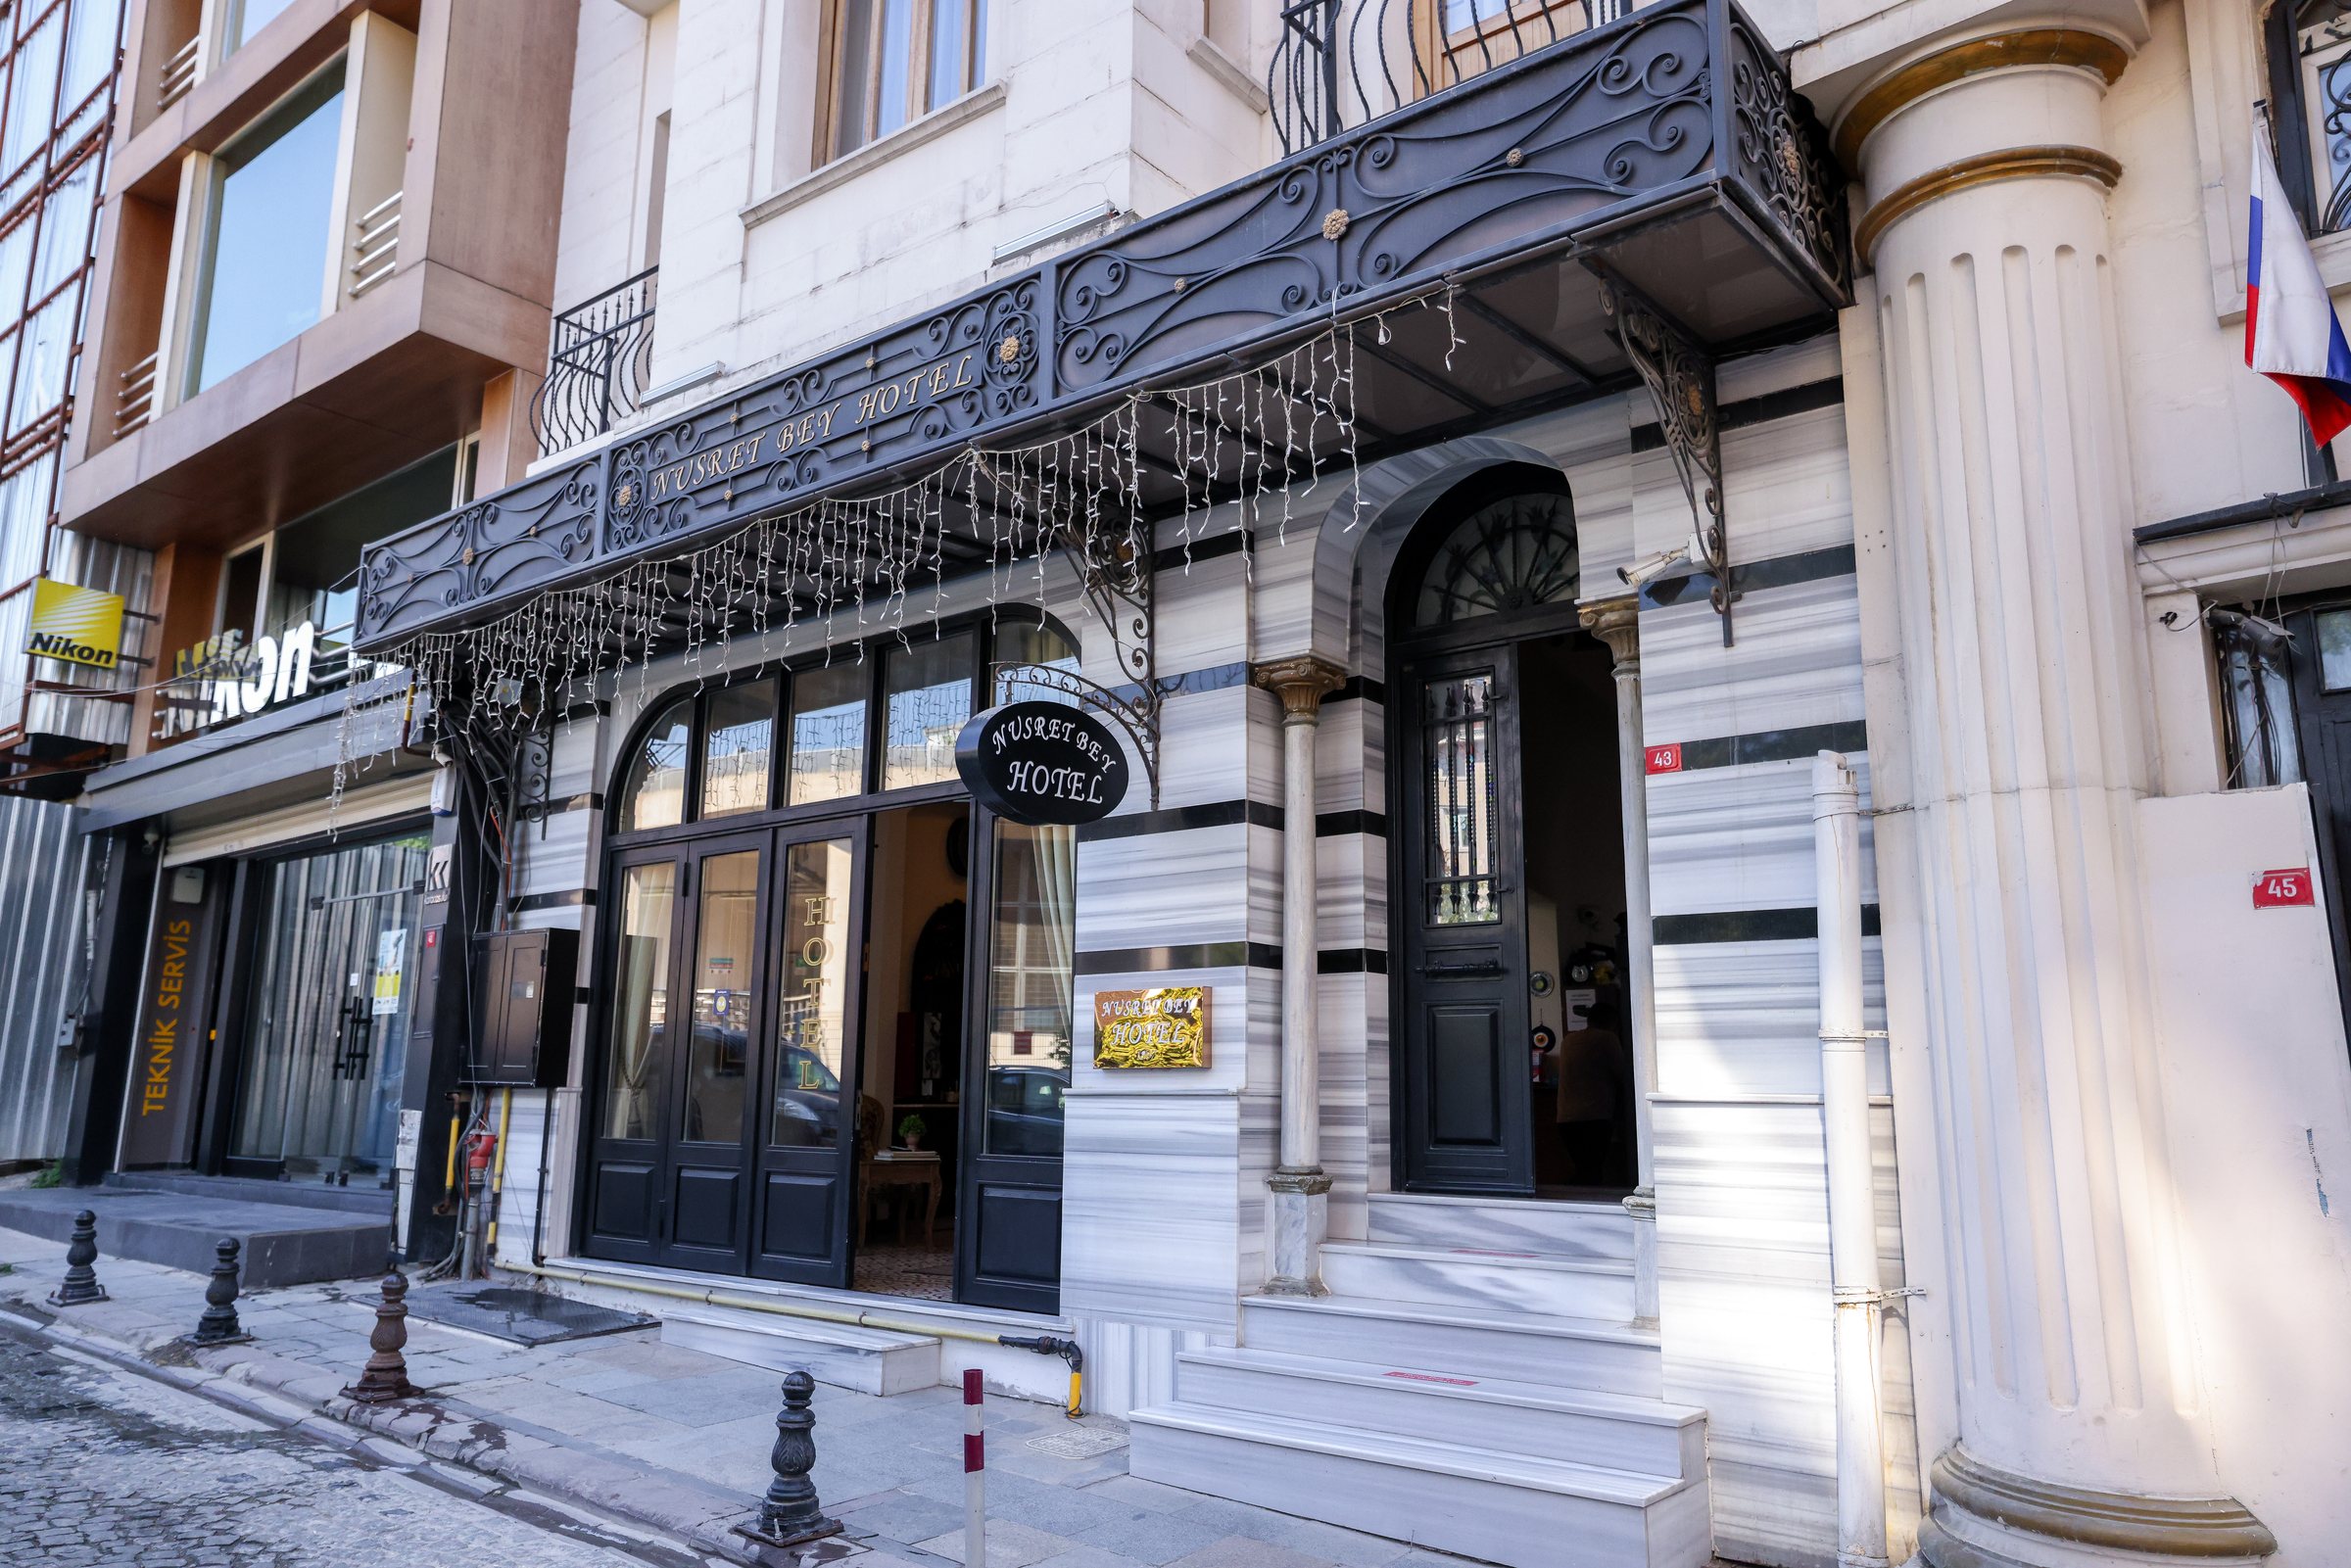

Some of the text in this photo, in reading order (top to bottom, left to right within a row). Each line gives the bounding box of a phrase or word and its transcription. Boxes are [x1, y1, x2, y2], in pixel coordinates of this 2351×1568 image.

[650, 355, 974, 501] NUSRET BEY HOTEL
[29, 632, 115, 666] Nikon
[992, 715, 1117, 774] NUSRET BEY
[1654, 751, 1672, 767] 43
[1007, 760, 1103, 805] HOTEL
[2268, 878, 2297, 898] 45
[797, 896, 830, 1090] HOTEL
[1101, 997, 1162, 1018] NUSRET
[142, 919, 191, 1117] TEKNİK SERVİS
[1111, 1021, 1187, 1046] HOTEL
